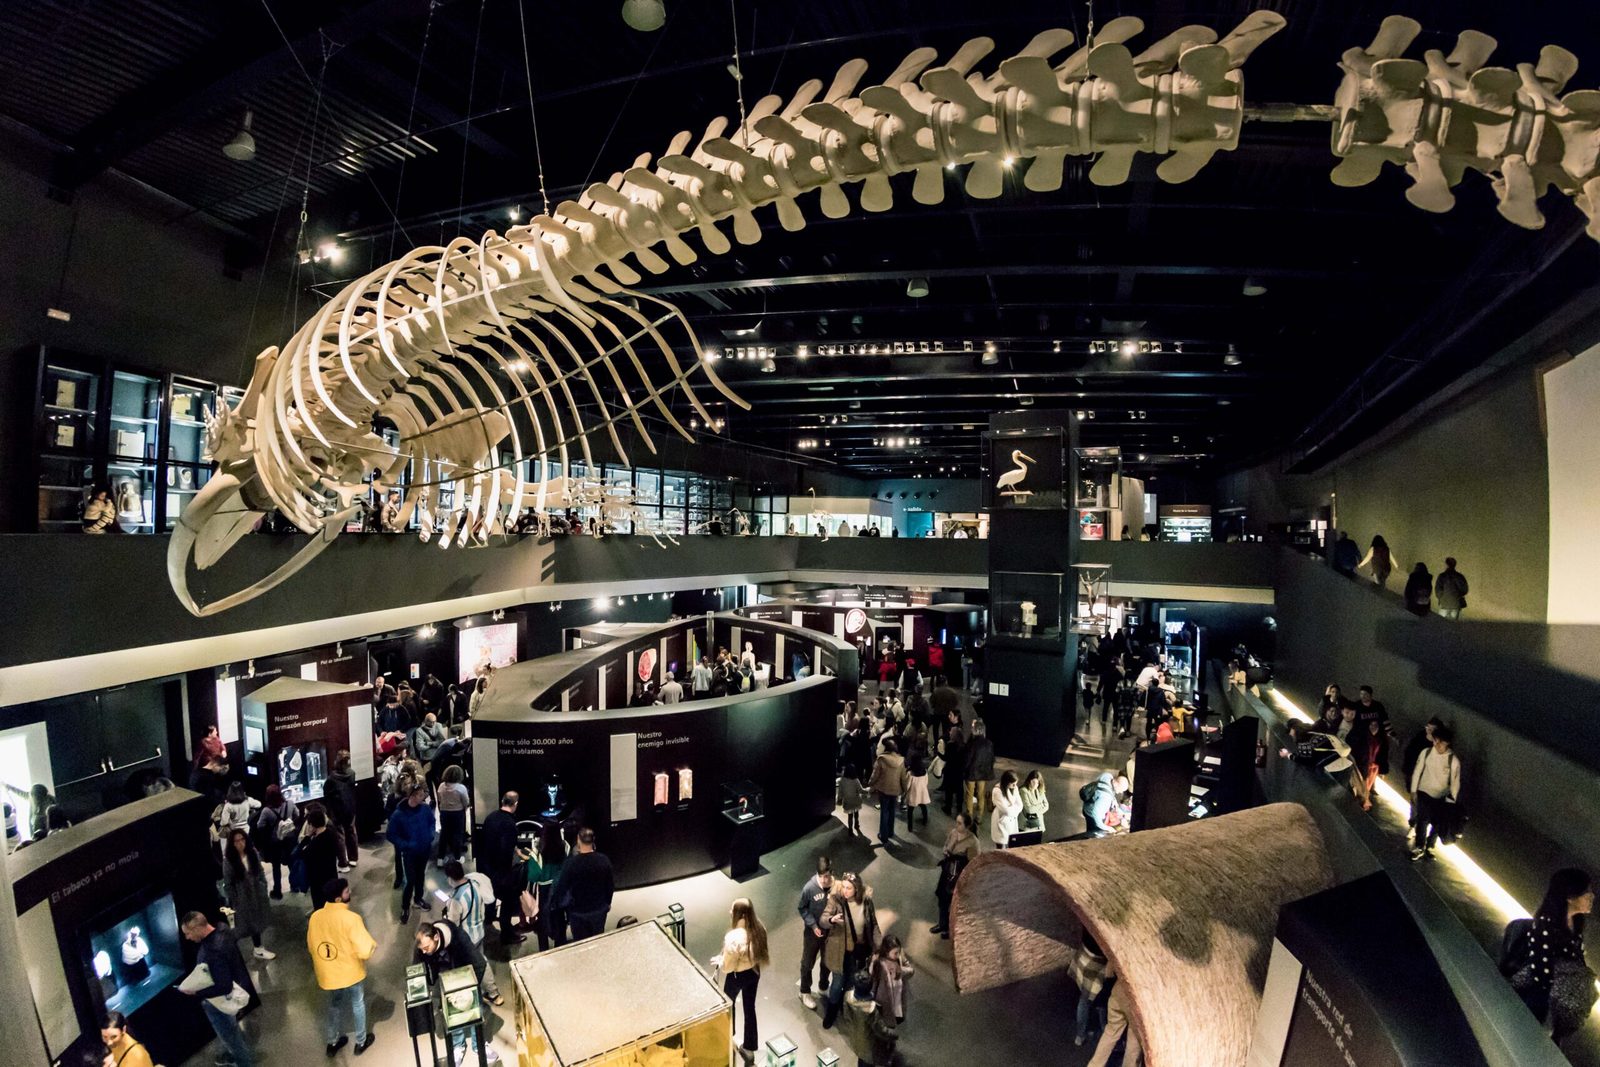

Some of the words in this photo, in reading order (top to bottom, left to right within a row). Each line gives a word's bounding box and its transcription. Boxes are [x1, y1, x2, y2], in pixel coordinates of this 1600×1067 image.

[274, 714, 299, 723] Nuestro
[274, 722, 302, 731] armazón
[302, 717, 328, 727] corporal
[499, 738, 515, 746] Hace
[516, 738, 531, 746] sólo
[532, 738, 556, 746] 30.000
[558, 737, 575, 745] años
[637, 732, 663, 740] Nuestro
[637, 741, 664, 749] enemigo
[665, 736, 690, 745] invisible
[512, 748, 544, 756] hablamos
[51, 891, 61, 904] El
[62, 875, 91, 897] tabaco
[92, 869, 103, 881] ya
[105, 862, 116, 873] no
[118, 850, 140, 867] mola
[1305, 969, 1331, 1009] Nuestra
[1302, 987, 1336, 1039] transporte
